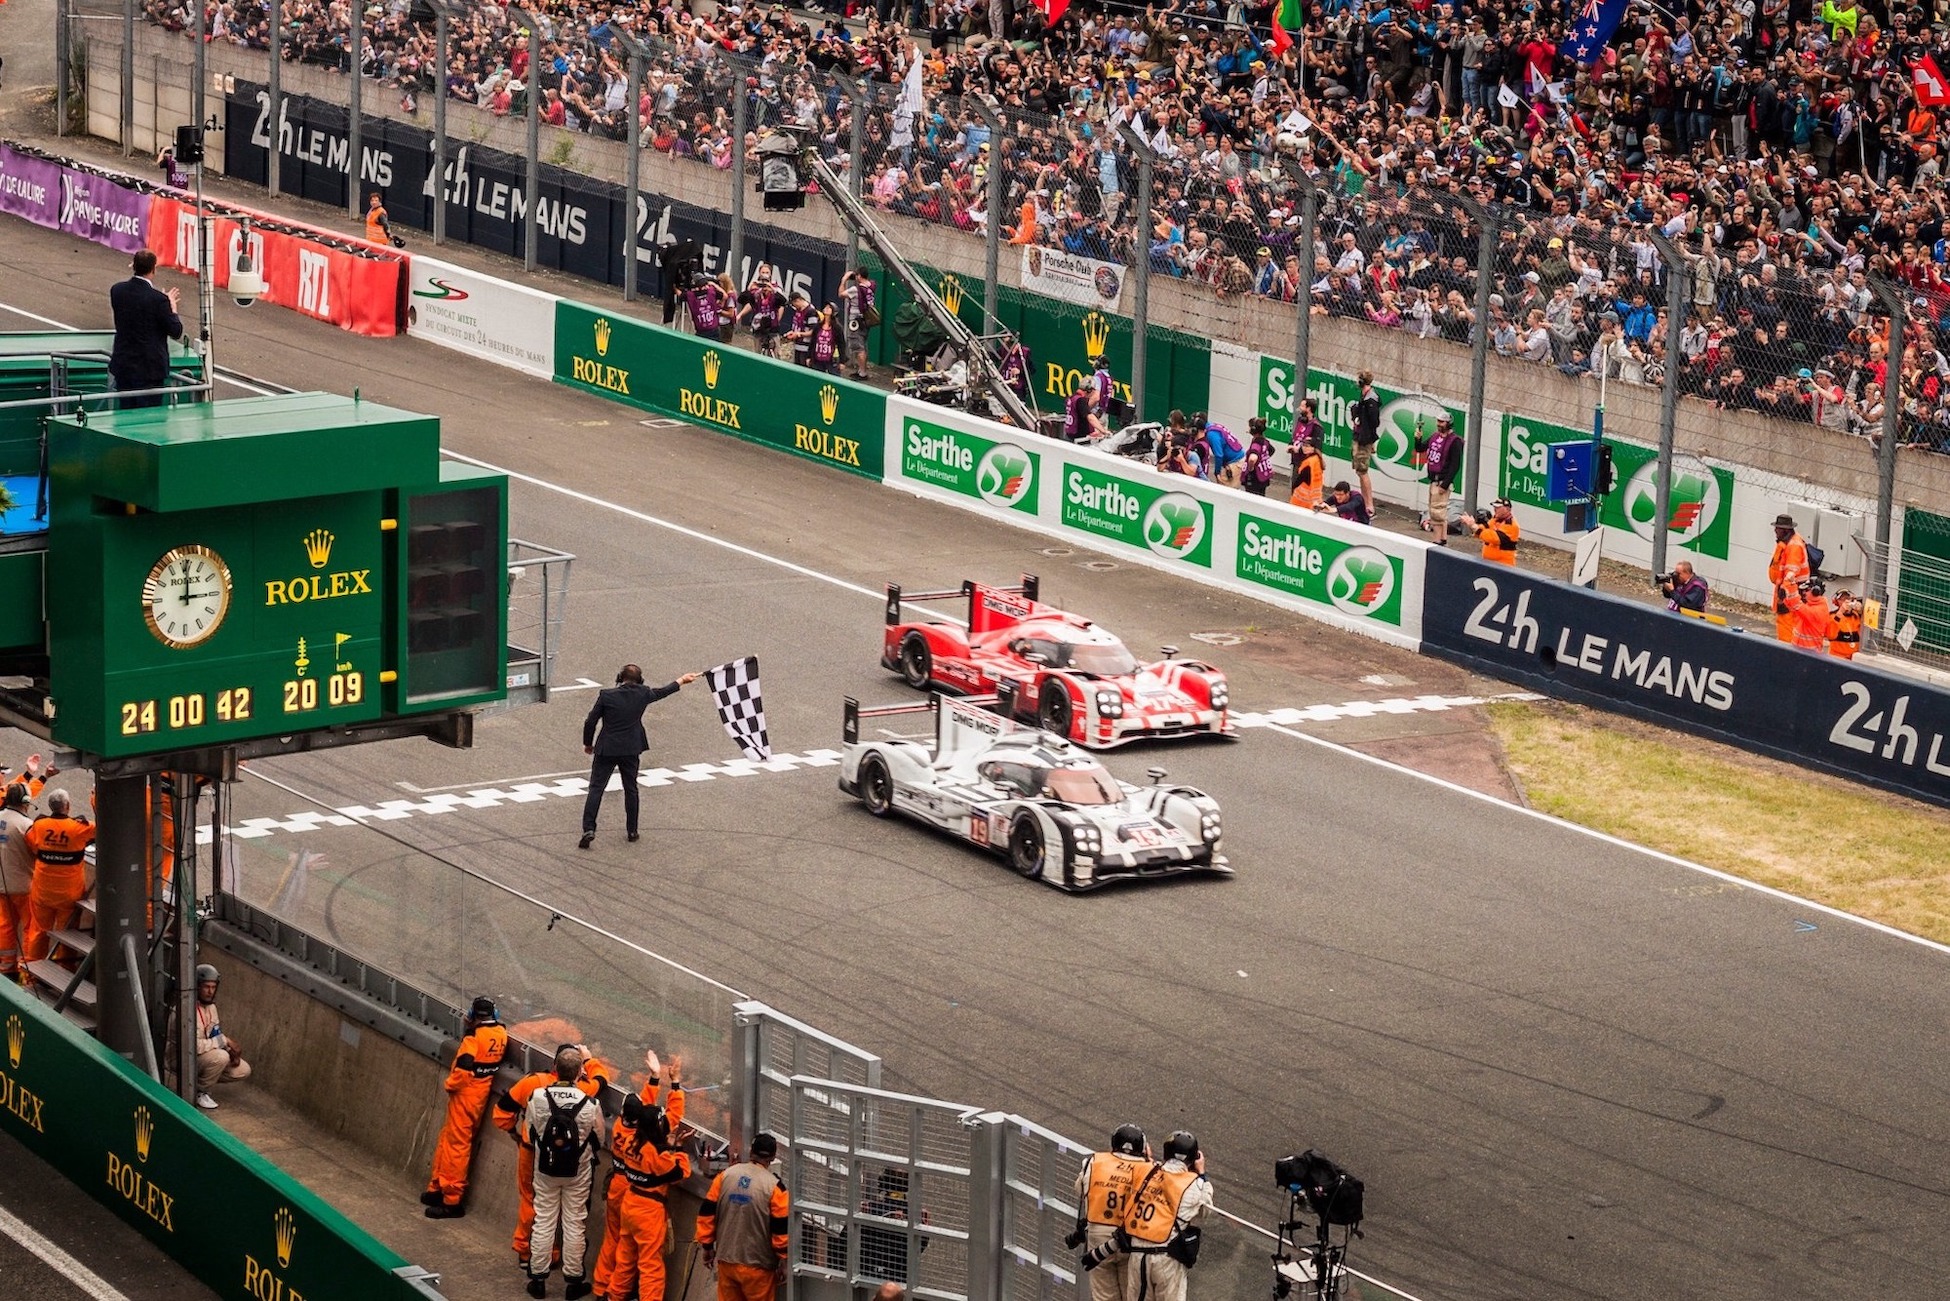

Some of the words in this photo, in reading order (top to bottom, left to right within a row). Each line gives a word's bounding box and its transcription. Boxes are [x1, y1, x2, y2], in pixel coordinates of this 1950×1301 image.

[251, 90, 294, 156] 2h
[296, 126, 326, 166] LE
[326, 135, 393, 188] MNS
[475, 177, 510, 220] LE
[510, 188, 587, 246] MANS
[297, 247, 331, 317] RTL
[1044, 252, 1074, 272] Porsche
[1075, 259, 1092, 276] Club
[425, 303, 456, 321] SYNDICAT
[457, 312, 478, 327] MIXTE
[425, 319, 435, 329] DU
[436, 321, 463, 339] CIRCUIT
[463, 331, 476, 343] DES
[476, 329, 487, 347] 24
[488, 339, 515, 355] HEURES
[515, 347, 525, 358] DU
[526, 350, 546, 365] MANS
[572, 356, 630, 395] ROLEX
[680, 388, 741, 429] ROLEX
[1264, 412, 1278, 429] Le
[795, 424, 861, 467] ROLEX
[907, 424, 974, 472] Sarthe
[906, 457, 917, 471] Le
[917, 459, 959, 485] Département
[1067, 471, 1140, 521] Sarthe
[1066, 505, 1077, 520] Le
[1077, 508, 1123, 535] Département
[1243, 521, 1323, 576] Sarthe
[170, 575, 201, 587] ROLEX
[265, 569, 372, 606] ROLEX
[1242, 556, 1253, 571] Le
[1254, 561, 1305, 588] Département
[1463, 576, 1540, 655] 24h
[1556, 627, 1608, 675] LE
[1611, 643, 1736, 712] MANS
[121, 701, 156, 736] 24
[169, 694, 203, 729] 00
[216, 687, 250, 722] 42
[284, 678, 316, 713] 20
[328, 671, 362, 706] 09
[1828, 680, 1919, 766] 24h
[972, 818, 988, 844] 19
[106, 1150, 176, 1233] ROLEX
[1107, 1191, 1127, 1211] 81
[1134, 1200, 1156, 1222] 50
